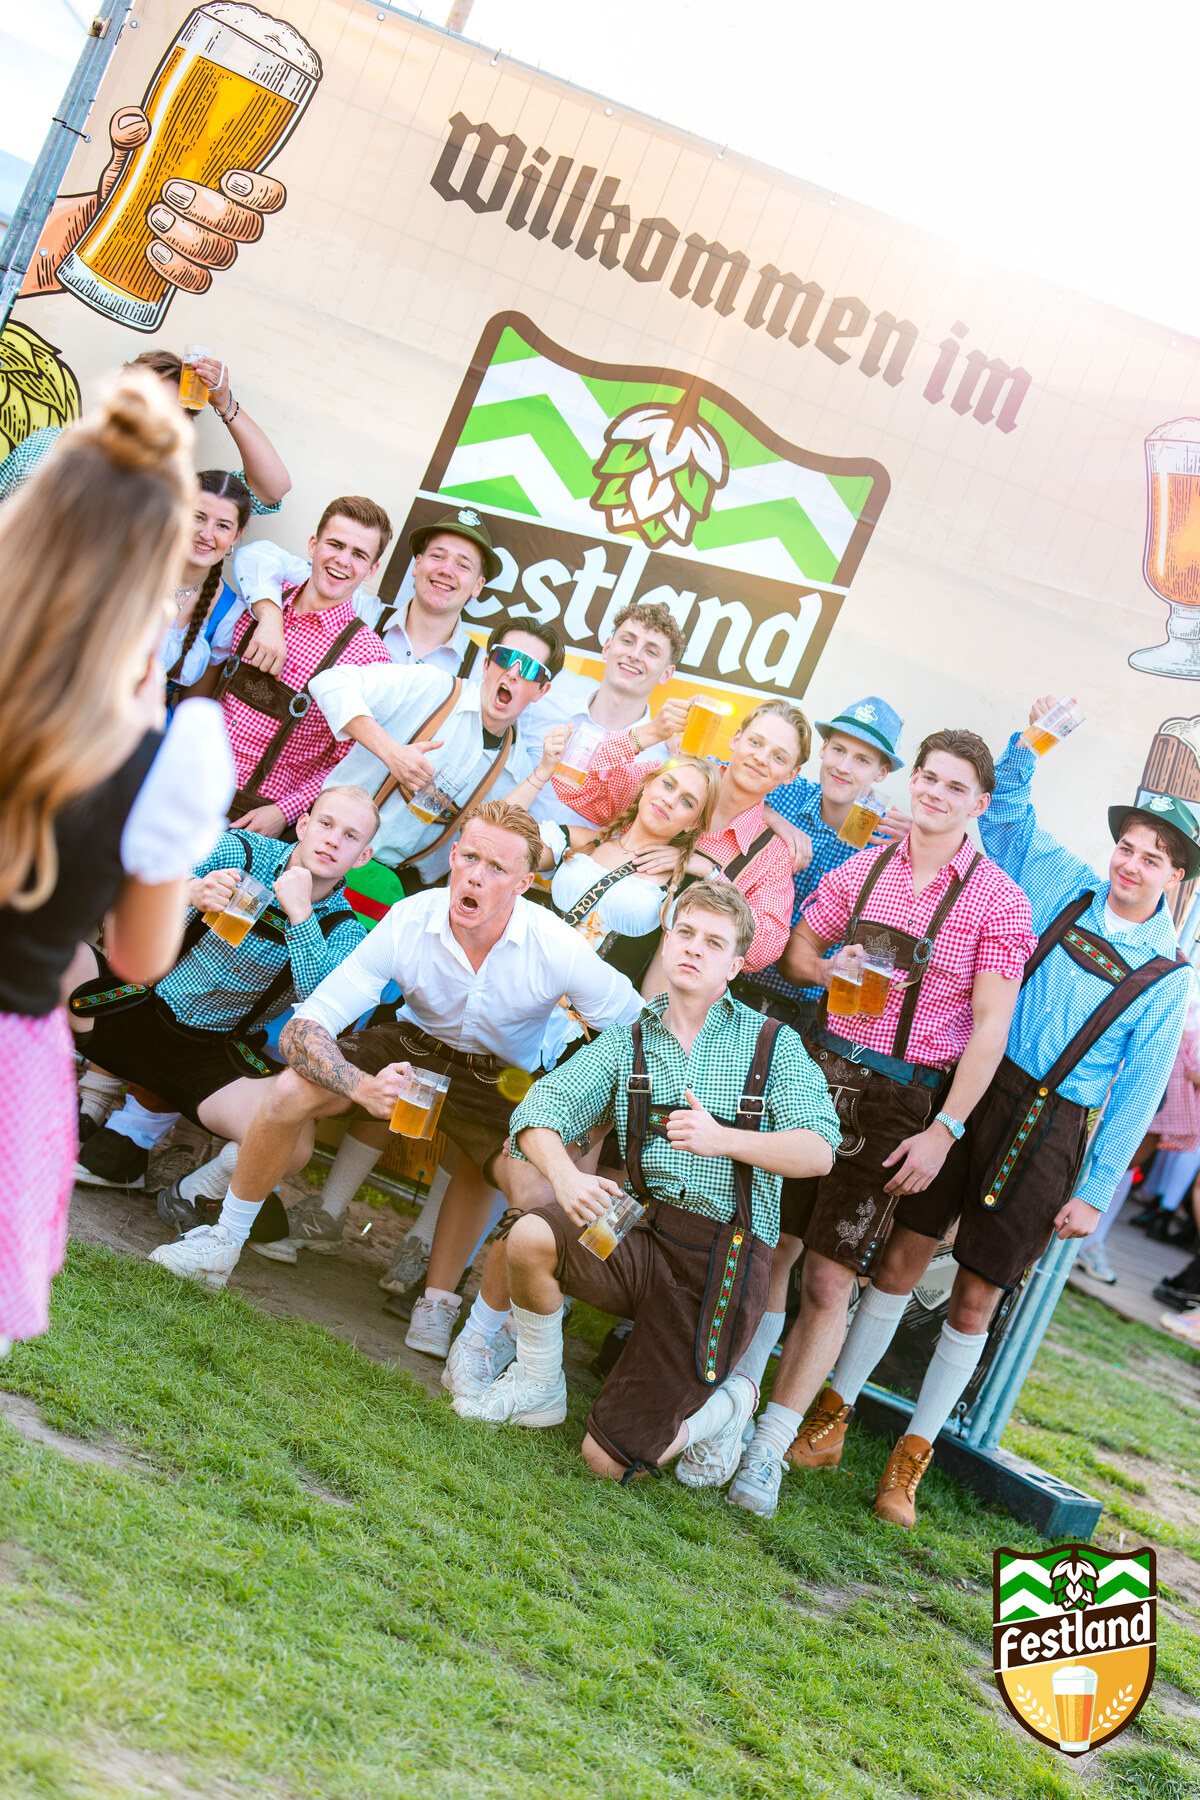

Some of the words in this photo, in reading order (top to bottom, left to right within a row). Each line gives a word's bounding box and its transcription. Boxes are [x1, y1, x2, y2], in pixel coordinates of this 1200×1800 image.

[430, 111, 919, 388] Willkommen
[922, 319, 1034, 435] im
[395, 545, 823, 689] estland
